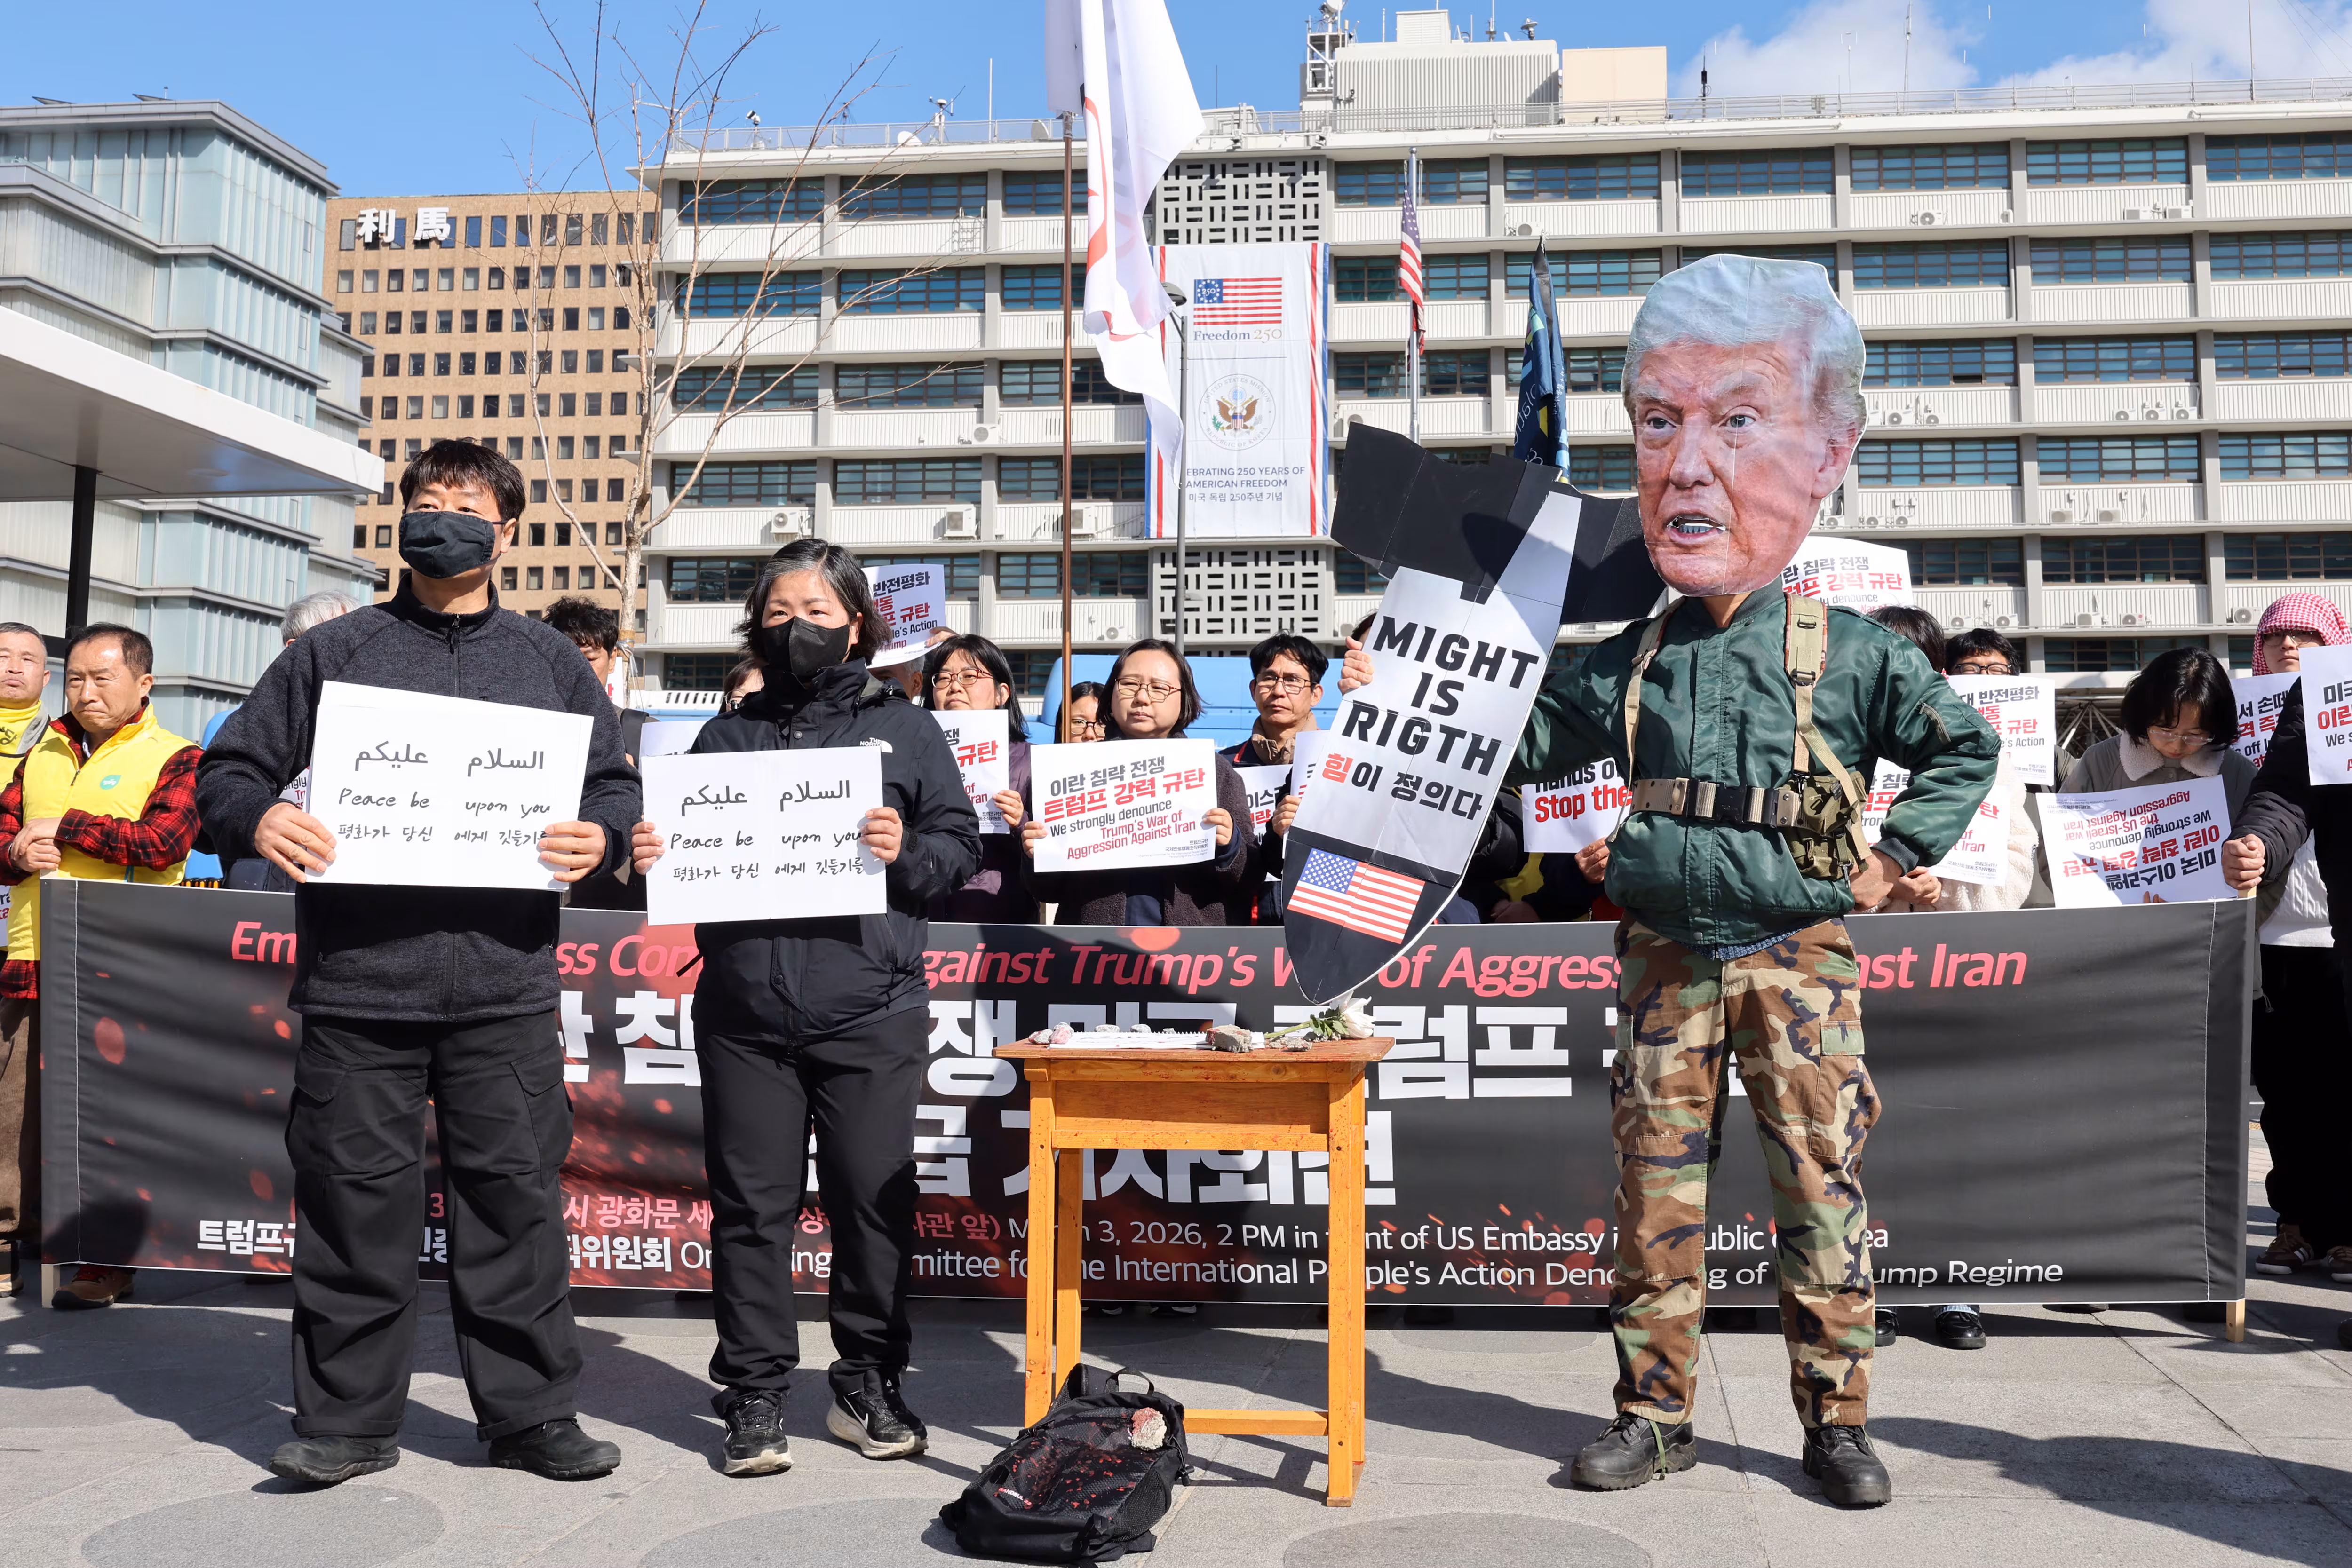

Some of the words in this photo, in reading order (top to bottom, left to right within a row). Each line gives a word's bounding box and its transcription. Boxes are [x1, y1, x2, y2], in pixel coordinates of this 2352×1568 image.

[1193, 330, 1250, 341] Freedom
[1253, 329, 1282, 344] 250
[1204, 382, 1223, 404] UNITED
[1224, 377, 1249, 385] STATES
[1249, 380, 1271, 403] MISSION
[1189, 493, 1206, 502] 미국
[1209, 493, 1226, 502] 독립
[1230, 492, 1263, 502] 250주년
[1266, 492, 1283, 501] 기념
[1804, 558, 1835, 576] 침략
[1840, 557, 1869, 570] 전쟁
[873, 571, 930, 597] 반전평화
[1827, 573, 1863, 591] 강력
[1868, 573, 1902, 590] 규탄
[1833, 594, 1878, 603] denounce
[900, 602, 930, 623] 규탄
[910, 620, 937, 634] Action
[1372, 615, 1539, 689] MIGHT
[1411, 672, 1465, 717] IS
[1979, 686, 2039, 705] 반전평화
[1343, 699, 1501, 776] RIGTH
[2008, 719, 2037, 734] 규탄
[2016, 737, 2044, 747] Action
[2245, 740, 2260, 756] off
[2326, 734, 2344, 747] We
[355, 741, 428, 771] عليكم
[467, 748, 544, 777] السلام
[957, 740, 998, 767] 규탄
[1050, 774, 1085, 796] 이란
[1091, 765, 1126, 788] 침략
[1131, 756, 1165, 778] 전쟁
[1322, 753, 1383, 792] 힘이
[1391, 771, 1482, 820] 정의다
[681, 784, 747, 816] عليكم
[779, 780, 850, 812] السلام
[965, 783, 975, 794] of
[970, 793, 987, 804] Iran
[1045, 788, 1107, 823] 트럼프
[1114, 777, 1156, 805] 강력
[1163, 768, 1205, 794] 규탄
[339, 788, 396, 807] Peace
[411, 792, 430, 808] be
[466, 800, 507, 816] upon
[521, 804, 550, 822] you
[1535, 793, 1585, 822] Stop
[1592, 784, 1633, 811] the
[2129, 790, 2190, 817] Aggression
[1050, 824, 1067, 837] We
[1070, 812, 1116, 832] strongly
[1119, 800, 1172, 820] denounce
[1101, 819, 1144, 839] Trump's
[1147, 815, 1168, 828] War
[1171, 810, 1182, 822] of
[2063, 821, 2083, 832] Iran
[2087, 810, 2126, 826] Against
[2140, 813, 2159, 826] the
[2193, 810, 2211, 822] We
[338, 824, 390, 839] 평화가
[403, 827, 433, 842] 당신
[454, 830, 487, 842] 에게
[1961, 830, 1973, 839] of
[2065, 832, 2082, 842] war
[2086, 819, 2137, 838] US-Israeli
[2145, 817, 2191, 839] strongly
[2183, 825, 2220, 852] 이란
[671, 833, 723, 849] Peace
[736, 830, 753, 846] be
[782, 834, 821, 850] upon
[834, 832, 862, 847] you
[1067, 837, 1128, 860] Aggression
[1131, 826, 1172, 843] Against
[1175, 821, 1195, 834] Iran
[1962, 841, 1985, 852] Iran
[2089, 832, 2142, 850] denounce
[2142, 838, 2179, 864] 침략
[673, 866, 721, 882] 평화가
[731, 863, 759, 880] 당신
[775, 862, 805, 875] 에게
[816, 857, 863, 875] 깃들기를
[2063, 858, 2097, 877] 규탄
[2102, 851, 2137, 872] 강력
[2181, 848, 2216, 875] 미국
[2105, 863, 2176, 891] 이스라엘
[1069, 945, 1257, 995] Trump's
[1378, 944, 1437, 989] of
[1929, 943, 2027, 989] Iran
[596, 1196, 681, 1229] 광화문
[961, 1214, 1000, 1241] 앞)
[1098, 1220, 1121, 1246] 3,
[1131, 1221, 1207, 1249] 2026,
[1217, 1224, 1232, 1246] 2
[1242, 1225, 1286, 1248] PM
[1295, 1225, 1317, 1248] in
[1401, 1225, 1430, 1250] of
[1438, 1227, 1474, 1250] US
[1484, 1226, 1605, 1255] Embassy
[1115, 1254, 1297, 1284] International
[1438, 1262, 1534, 1286] Action
[1737, 1261, 1768, 1284] of
[1947, 1259, 2062, 1284] Regime
